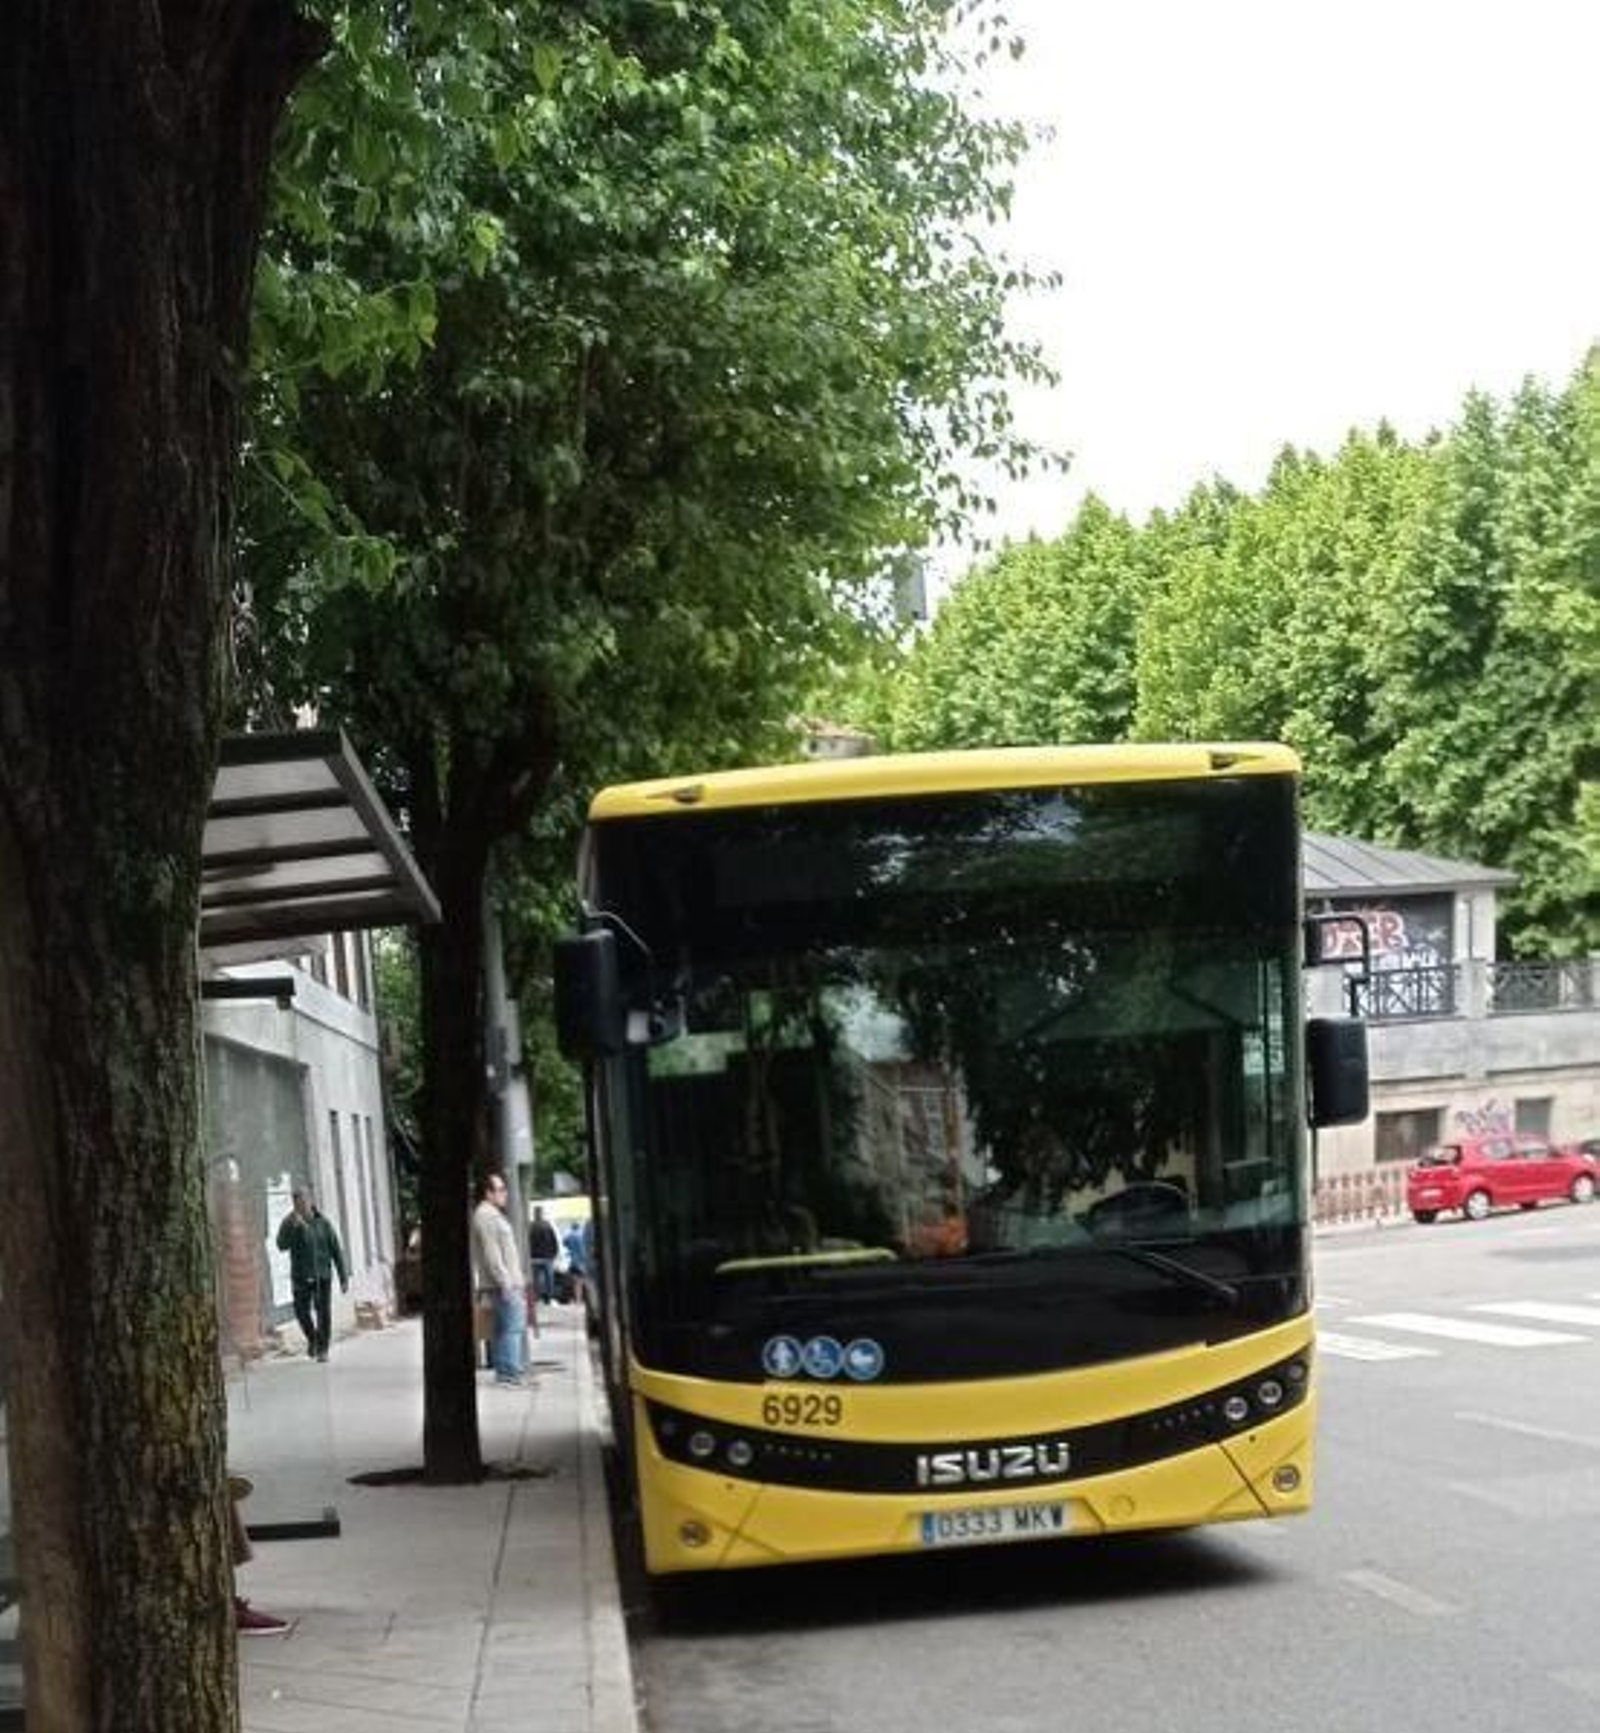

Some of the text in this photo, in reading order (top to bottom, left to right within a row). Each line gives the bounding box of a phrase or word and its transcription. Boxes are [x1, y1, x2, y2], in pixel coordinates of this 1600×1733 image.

[763, 1393, 842, 1426] 6929
[917, 1442, 1069, 1486] ISUZU
[938, 1512, 1002, 1538] 0333
